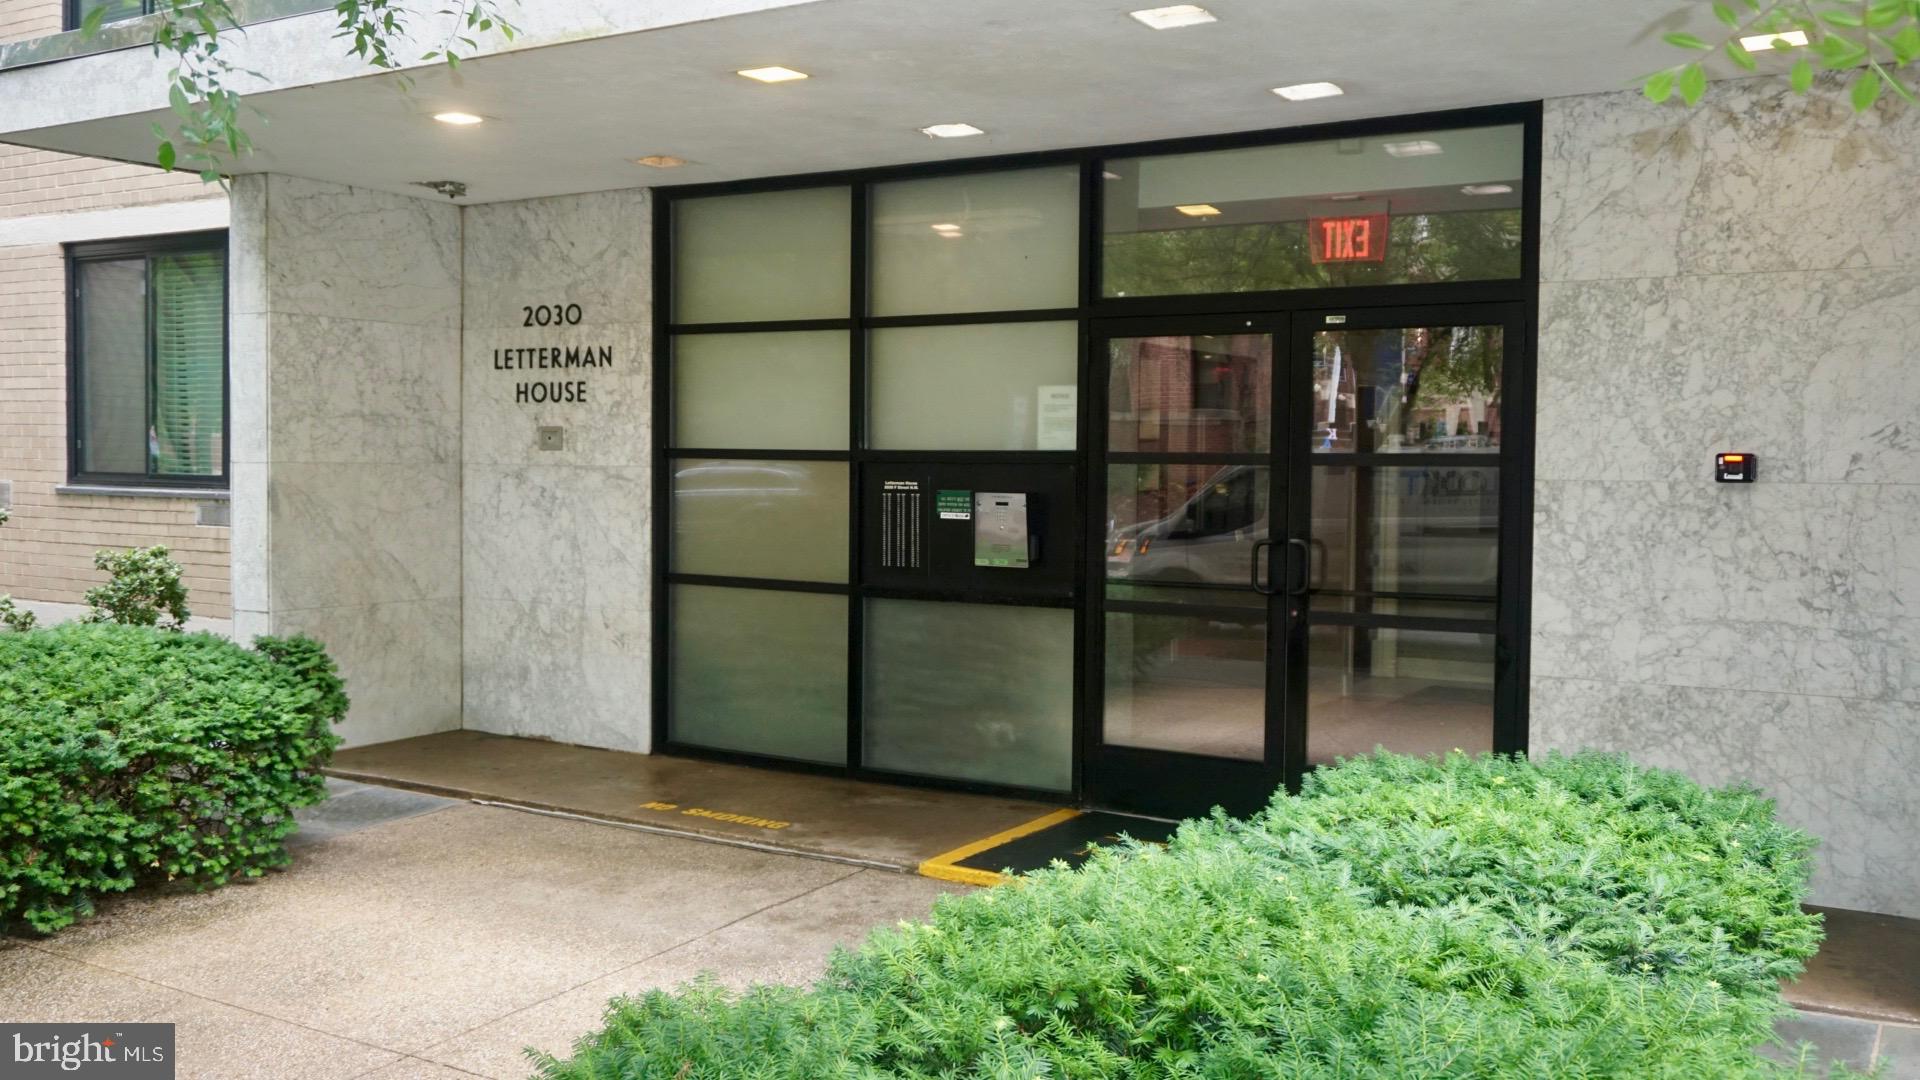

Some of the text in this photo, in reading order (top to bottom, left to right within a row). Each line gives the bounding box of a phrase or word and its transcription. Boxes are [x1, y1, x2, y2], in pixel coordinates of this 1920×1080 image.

[523, 303, 582, 327] 2030
[494, 345, 612, 369] LETTERMAN
[516, 381, 587, 403] HOUSE
[640, 801, 790, 829] NO SMOKING
